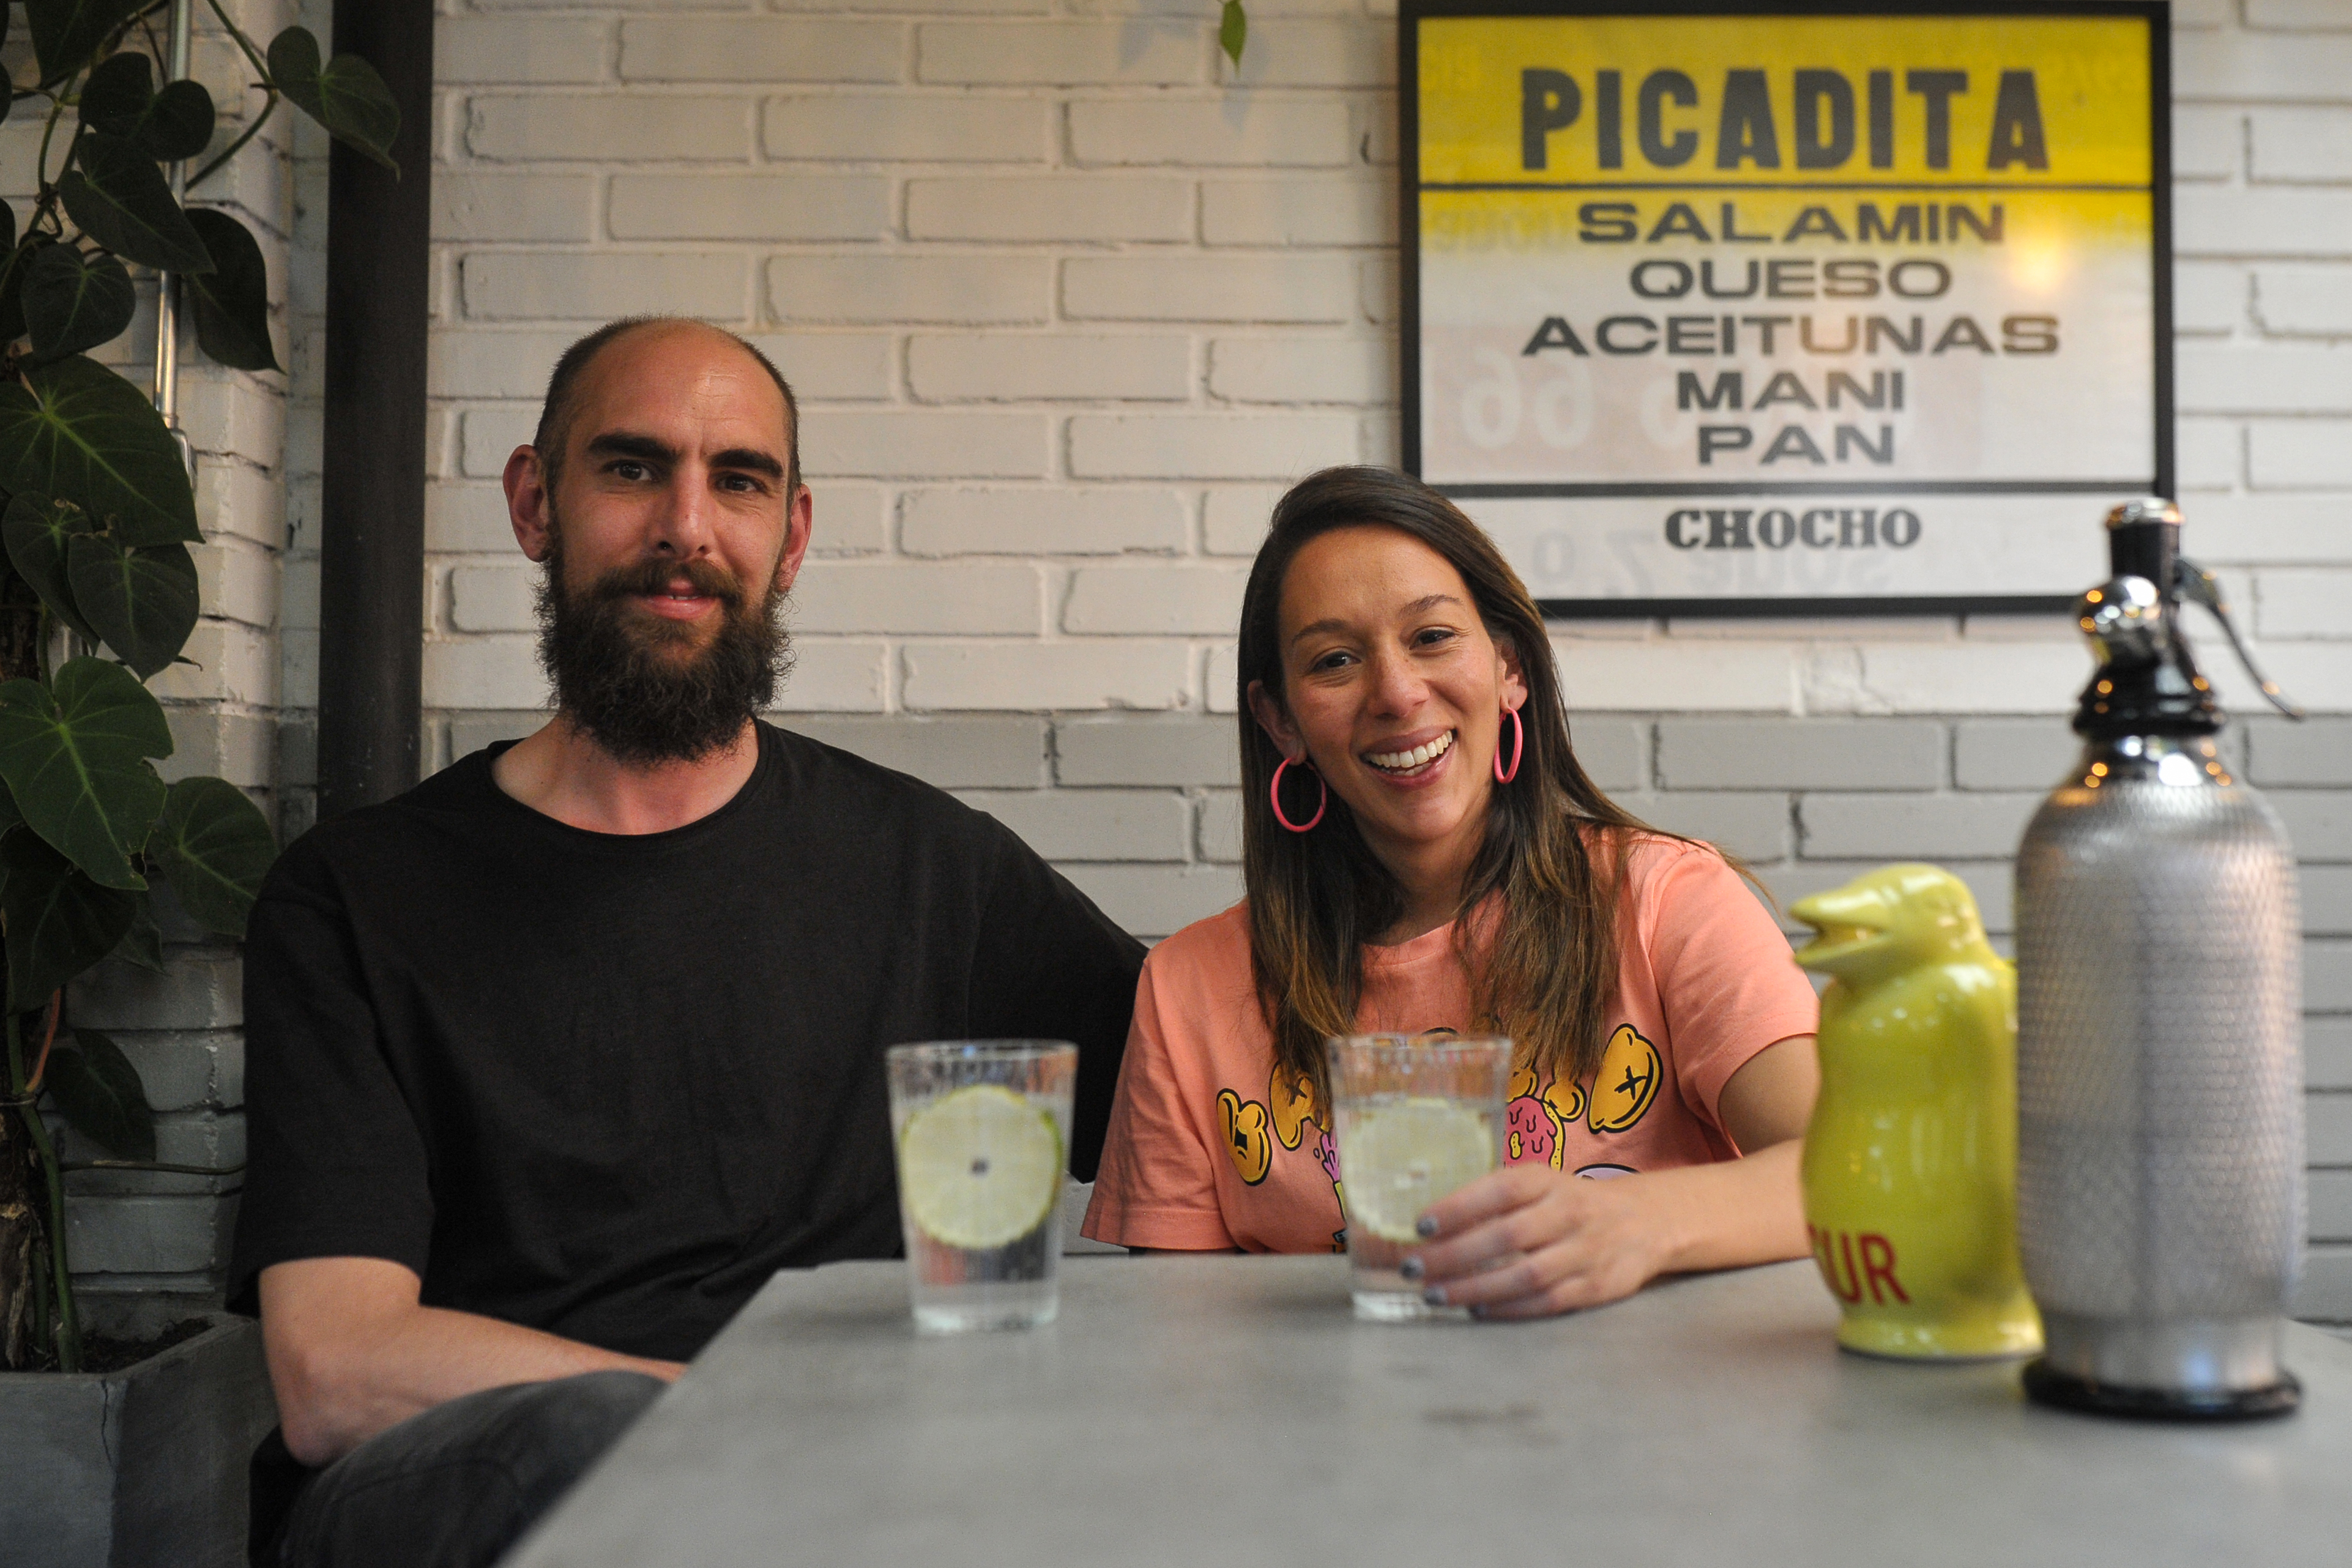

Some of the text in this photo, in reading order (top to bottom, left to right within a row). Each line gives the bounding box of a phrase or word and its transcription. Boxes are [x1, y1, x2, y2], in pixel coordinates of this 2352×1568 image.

[1521, 67, 2049, 171] PICADITA
[1578, 203, 2001, 243] SALAMIN
[1630, 259, 1952, 299] QUESO
[1522, 315, 2056, 356] ACEITUNAS
[1678, 371, 1902, 411] MANI
[1698, 425, 1892, 465] PAN
[1665, 510, 1919, 549] CHOCHO
[1808, 1225, 1910, 1306] UR
